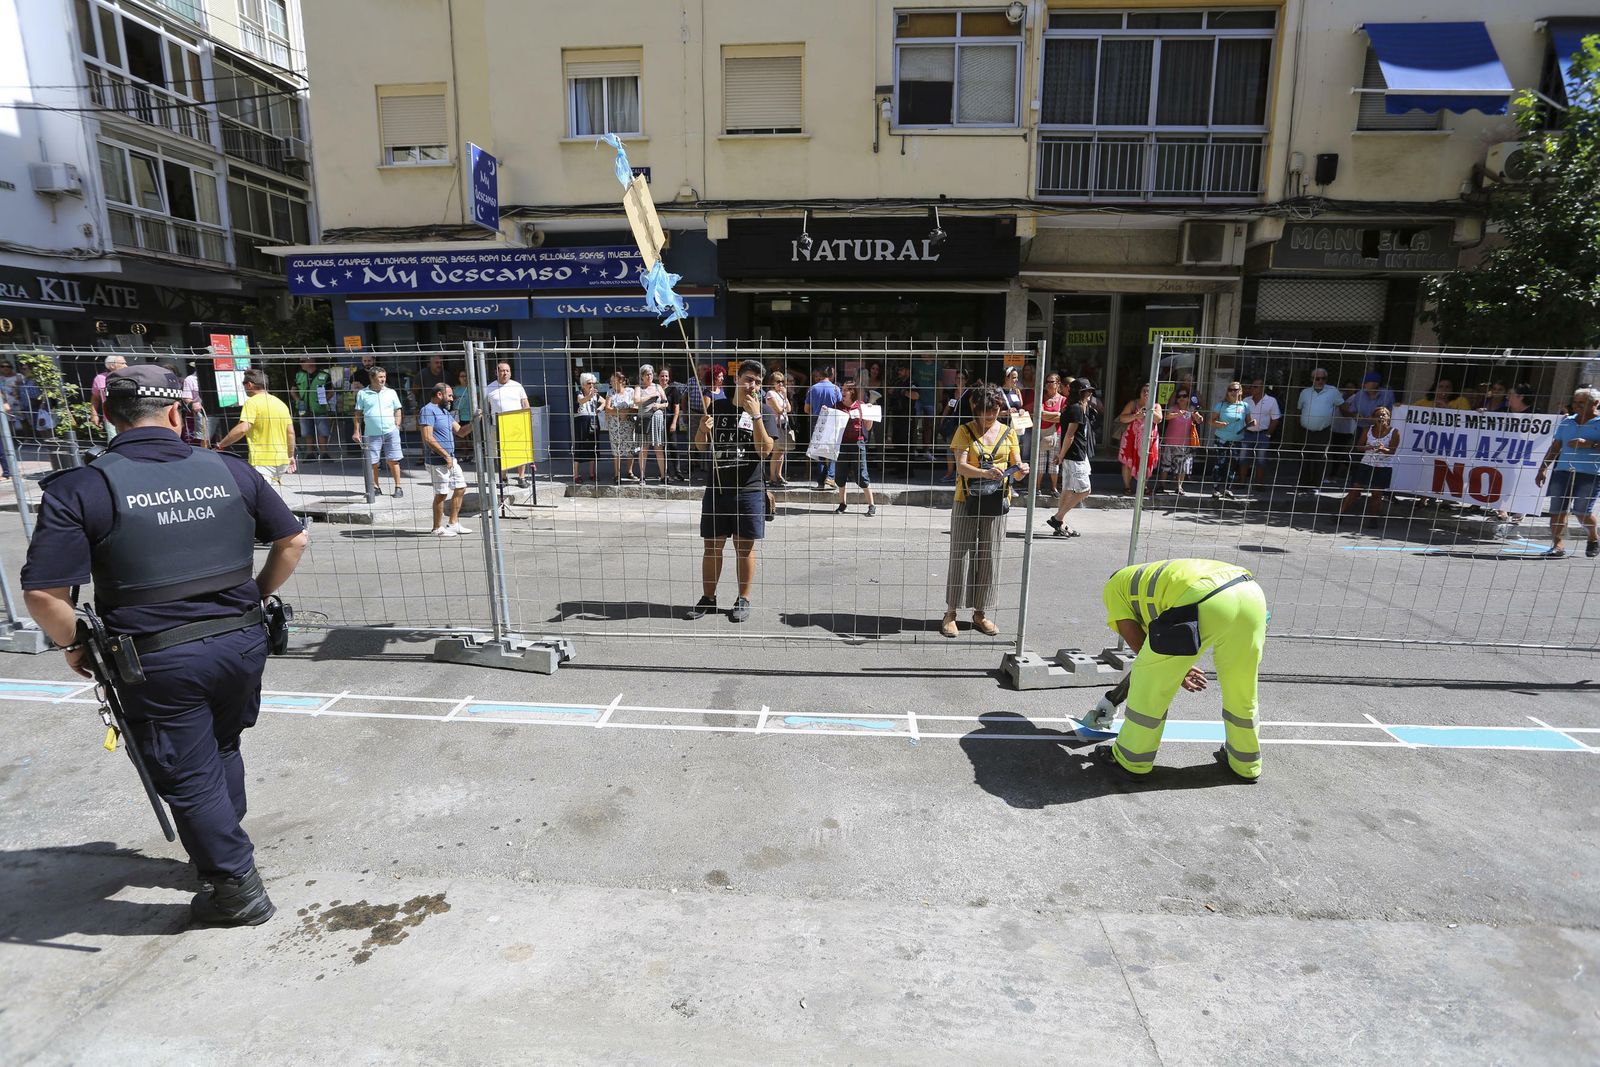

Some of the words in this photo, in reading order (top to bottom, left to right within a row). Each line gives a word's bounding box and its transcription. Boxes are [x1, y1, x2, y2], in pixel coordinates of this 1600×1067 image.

[480, 170, 490, 190] My
[475, 184, 496, 207] descanso
[479, 254, 499, 262] ROPA
[501, 254, 512, 262] DE
[791, 239, 941, 262] NATURAL
[363, 265, 417, 289] My
[430, 264, 572, 284] descanso
[36, 276, 140, 309] KILATE
[1068, 331, 1104, 343] REBAJAS
[1406, 410, 1461, 428] ALCALDE
[1465, 414, 1551, 435] MENTIROSO
[1412, 429, 1468, 458] ZONA
[1475, 436, 1537, 467] AZUL
[1432, 459, 1503, 503] NO
[126, 488, 184, 509] POLICÍA
[185, 485, 230, 502] LOCAL
[157, 506, 216, 526] MÁLAGA
